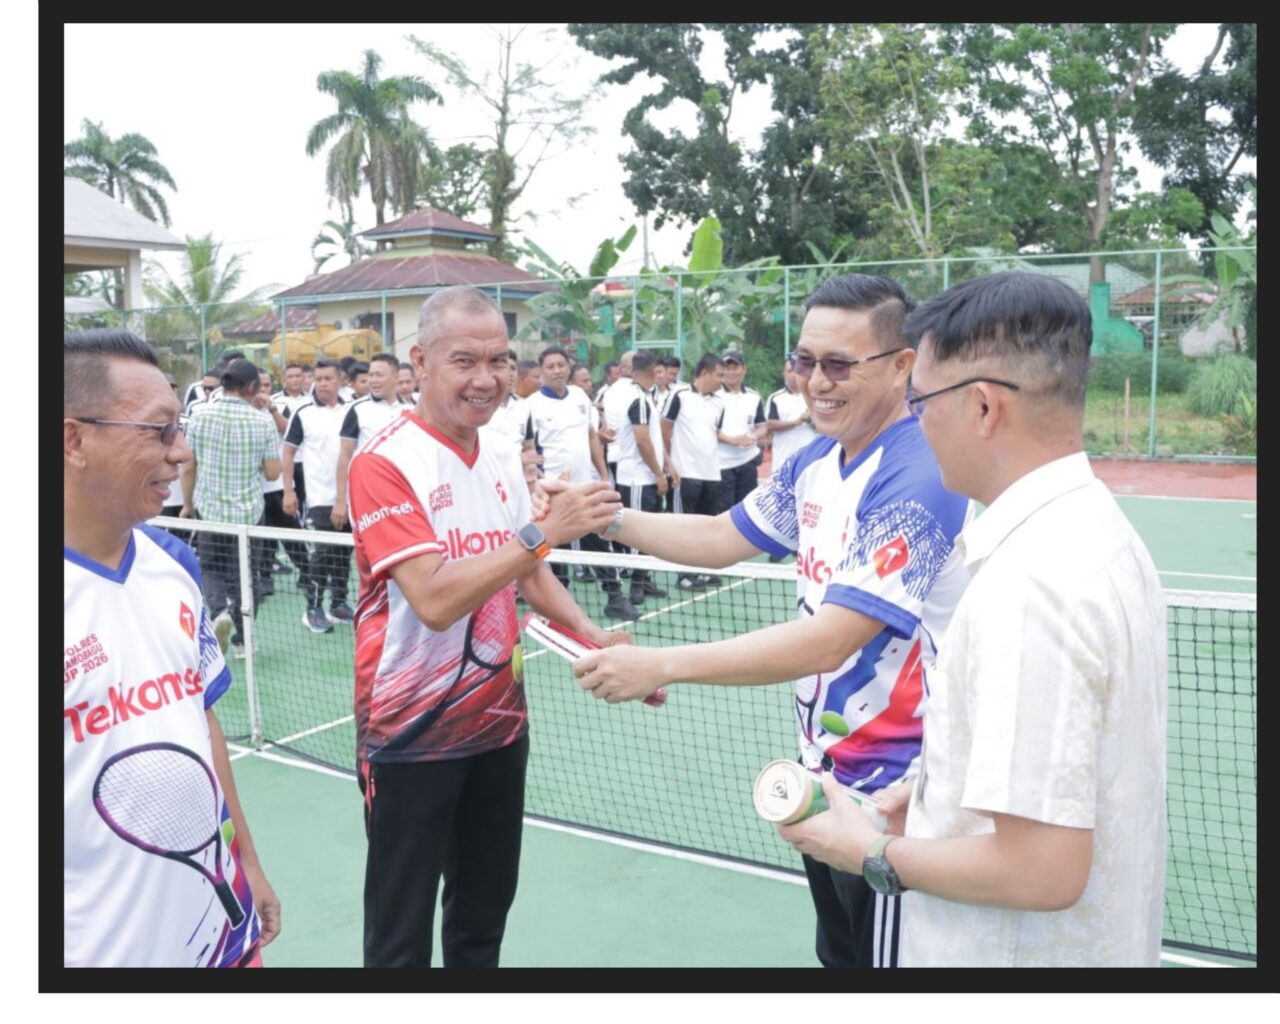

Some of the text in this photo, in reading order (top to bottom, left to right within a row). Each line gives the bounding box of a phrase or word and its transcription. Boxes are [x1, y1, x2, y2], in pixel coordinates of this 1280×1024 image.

[357, 500, 414, 533] elkomsel
[438, 528, 516, 561] elkom
[64, 633, 98, 657] OLRES
[82, 653, 109, 674] 2026
[64, 667, 203, 743] Telkomse
